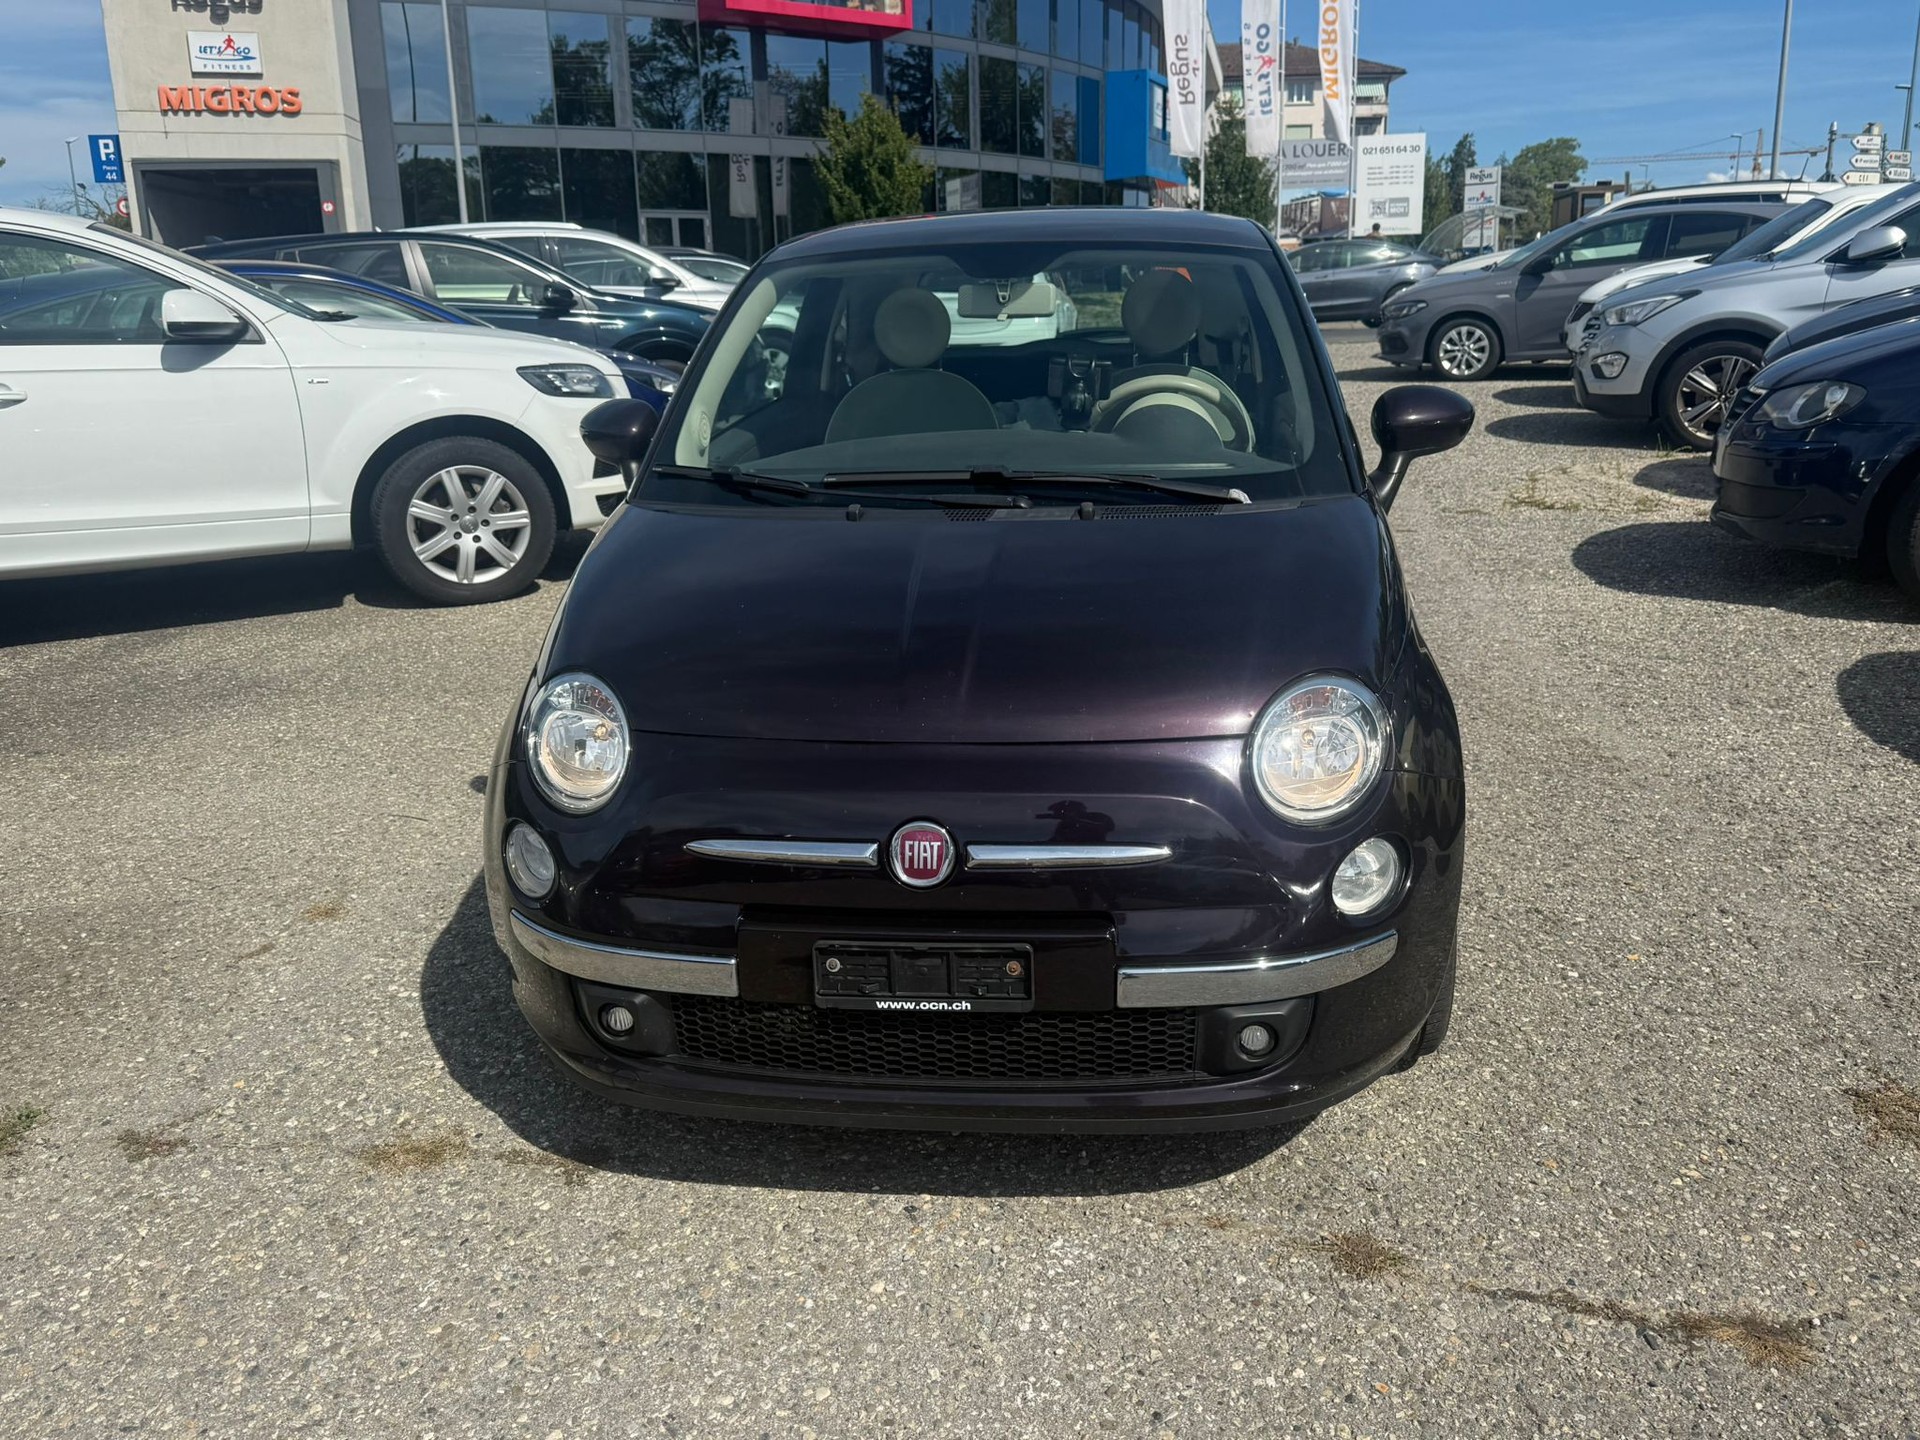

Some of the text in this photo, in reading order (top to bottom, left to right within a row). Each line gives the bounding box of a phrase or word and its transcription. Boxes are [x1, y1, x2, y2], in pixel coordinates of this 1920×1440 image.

[199, 46, 251, 55] LET'S GO
[158, 84, 302, 114] MIGROS
[98, 139, 115, 161] P
[1293, 143, 1348, 158] LOUER
[1362, 144, 1421, 155] 021 651 64 30
[105, 171, 117, 181] 44
[904, 840, 941, 870] FIAT
[876, 1001, 971, 1010] www.ocn.ch
